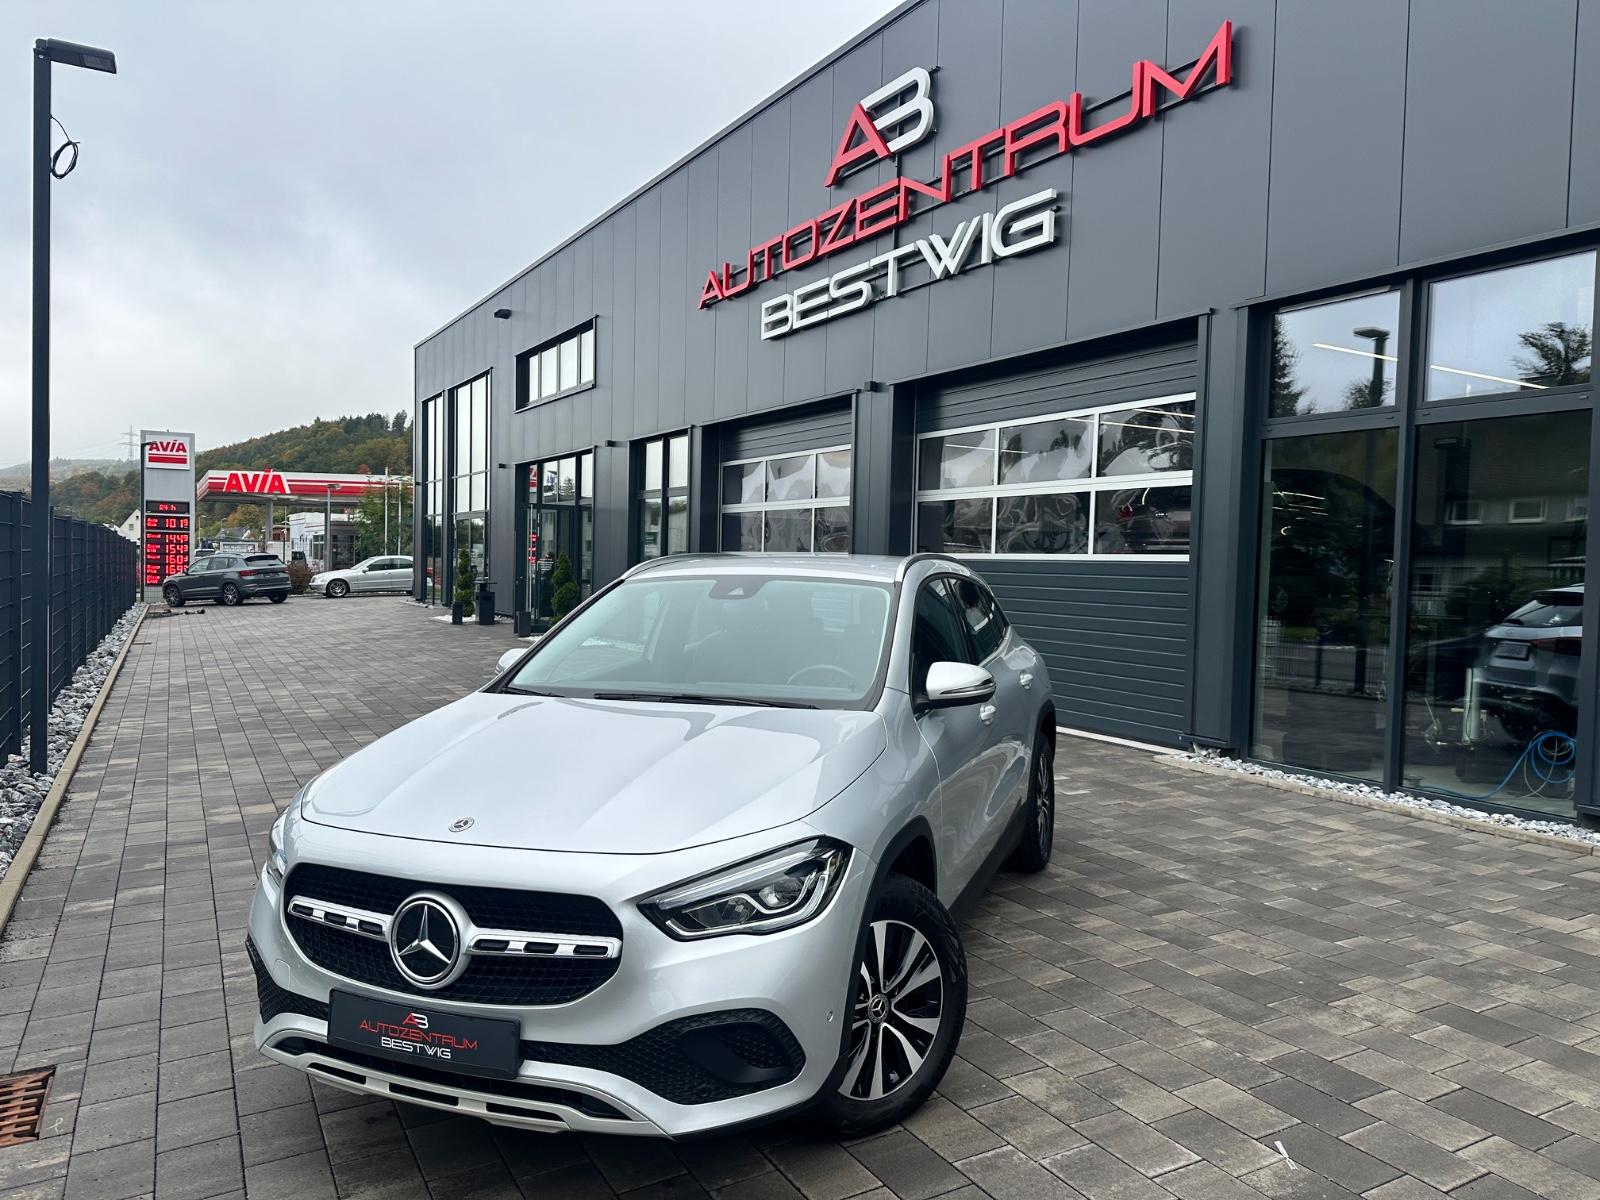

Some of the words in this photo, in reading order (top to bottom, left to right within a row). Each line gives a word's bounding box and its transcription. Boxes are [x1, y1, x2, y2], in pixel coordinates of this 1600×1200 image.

[824, 66, 935, 187] AB
[697, 19, 1233, 309] AUTOZENTRUM
[760, 188, 1057, 340] BESTWIG
[148, 439, 187, 453] AVIA
[223, 467, 291, 494] AVIA
[359, 1019, 478, 1051] AUTOZENTRUM
[402, 1012, 429, 1029] AB
[381, 1036, 451, 1059] BESTWIG
